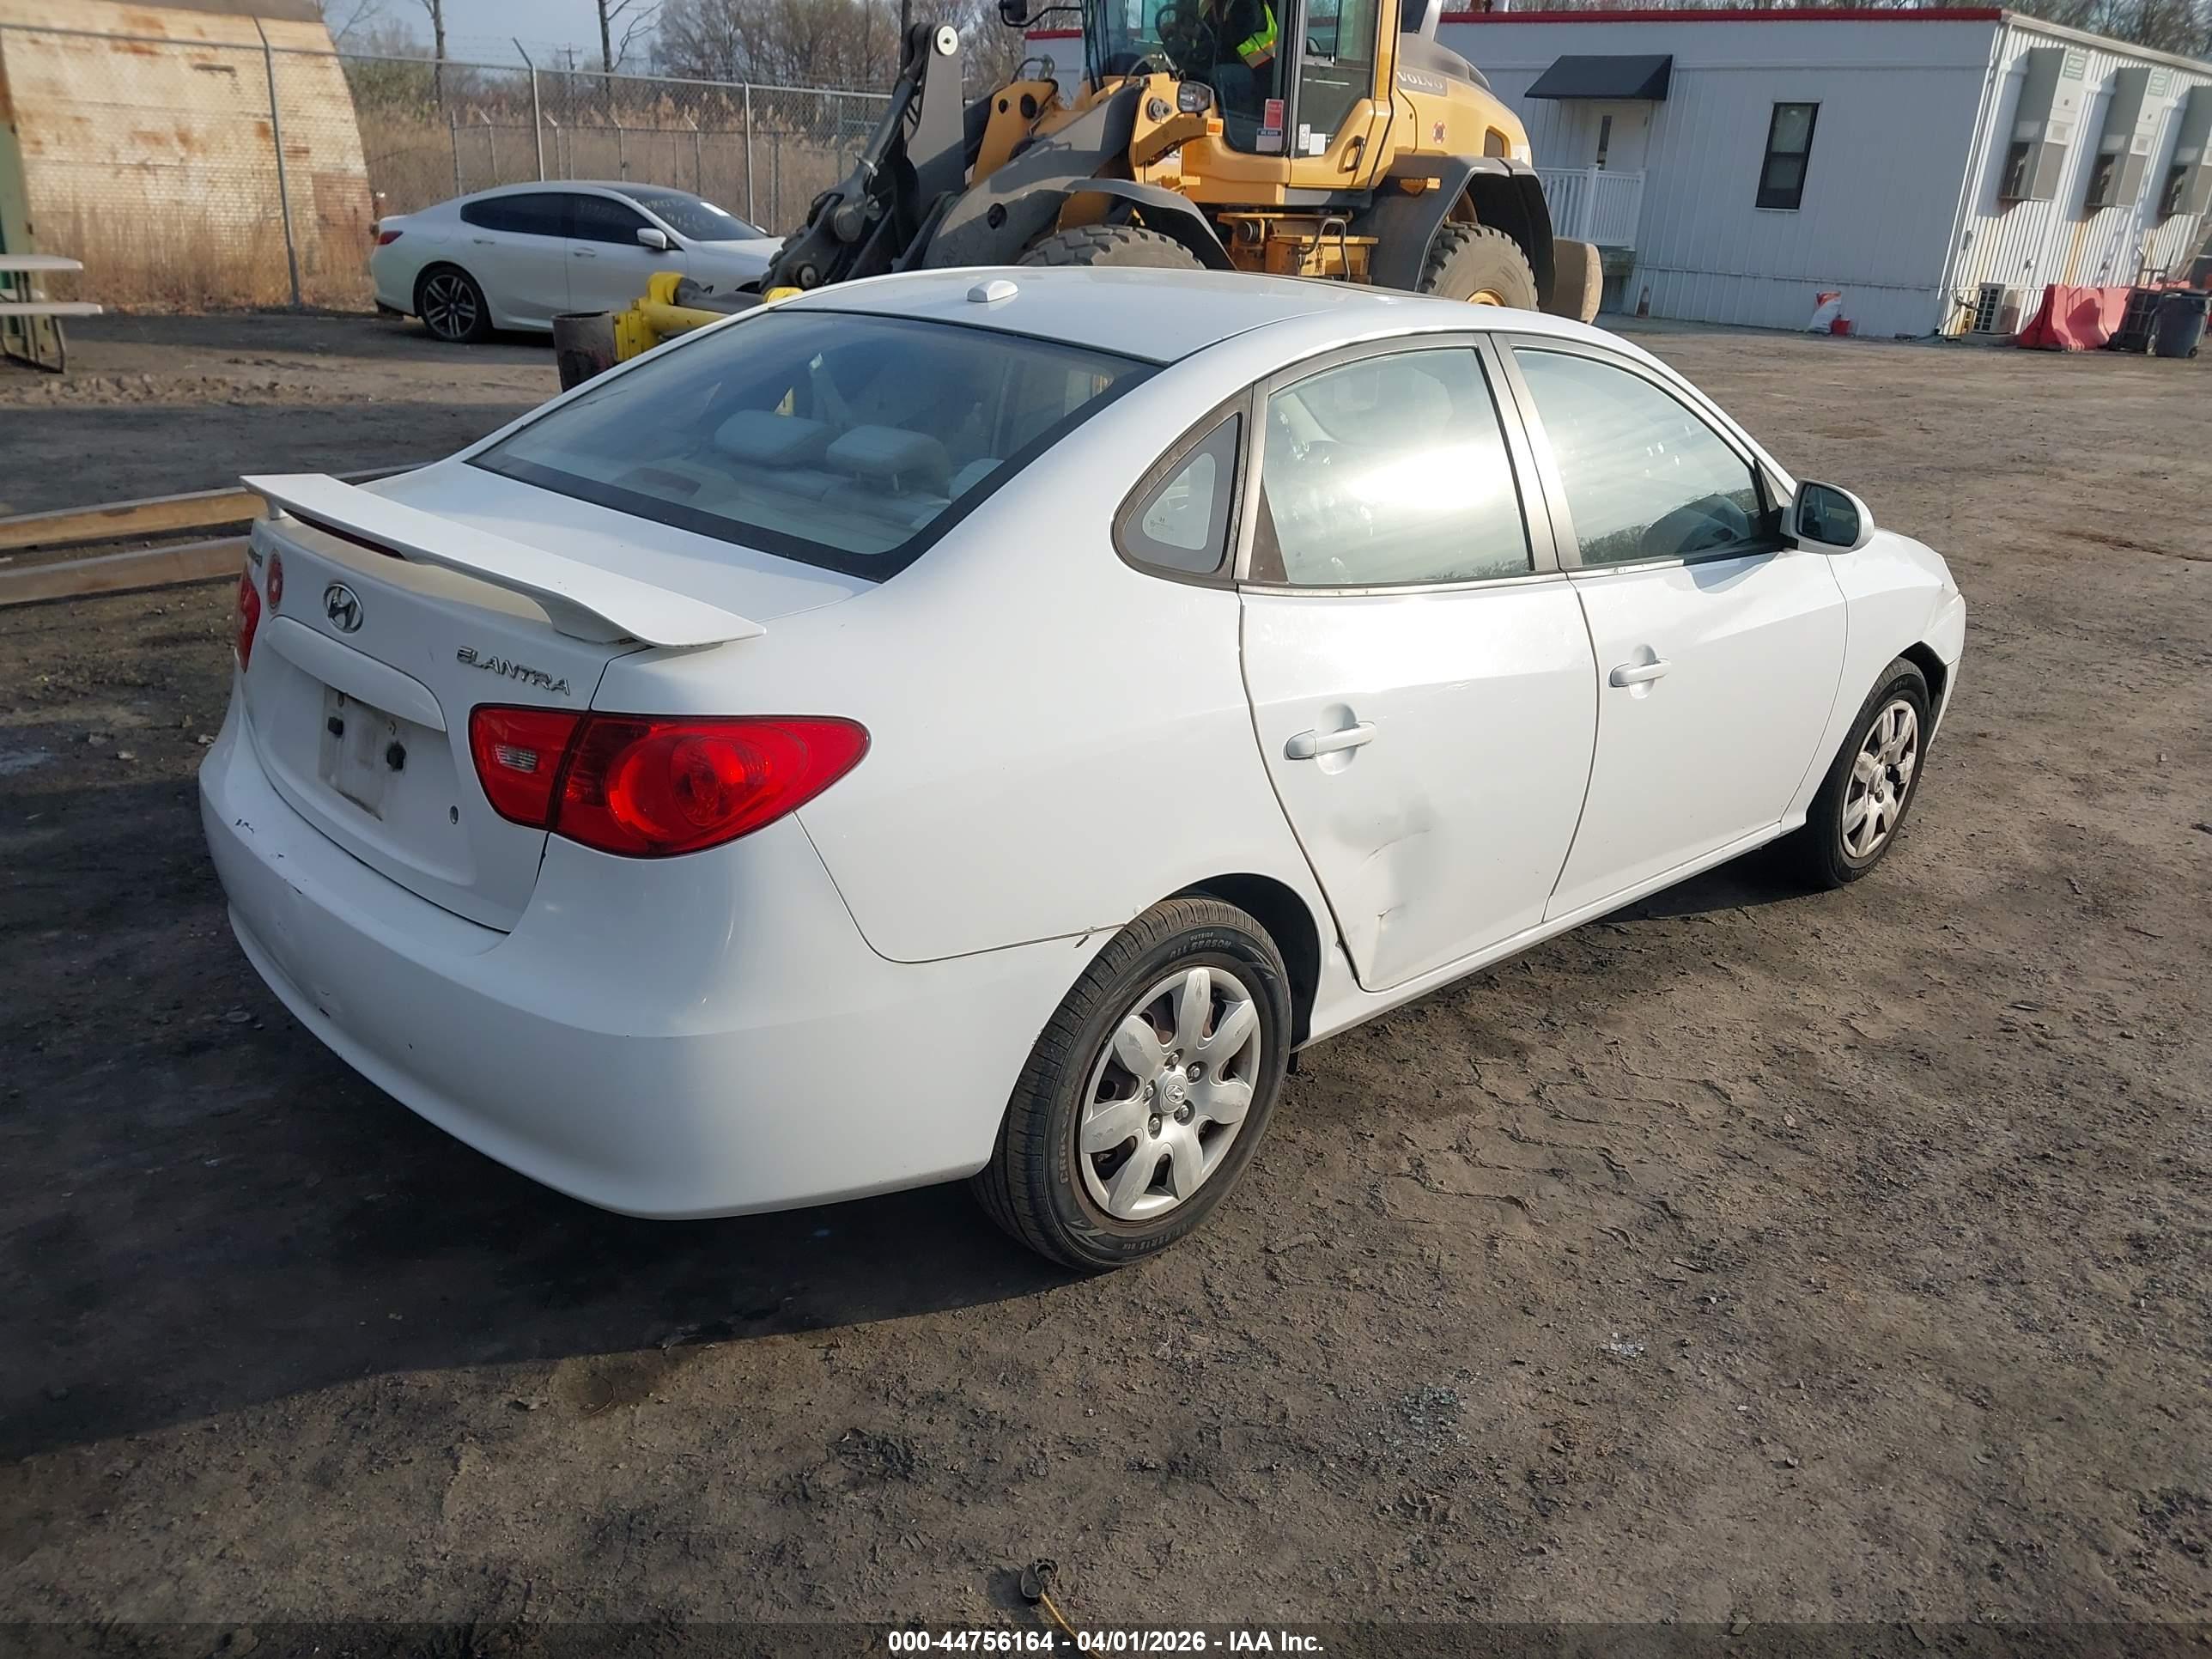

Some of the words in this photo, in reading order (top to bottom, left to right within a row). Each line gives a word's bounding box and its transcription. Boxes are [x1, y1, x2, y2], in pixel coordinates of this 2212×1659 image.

[1396, 71, 1443, 90] VOLVO
[457, 646, 571, 696] ELANTRA
[1169, 944, 1188, 959] ALL
[1190, 938, 1233, 952] SEASON
